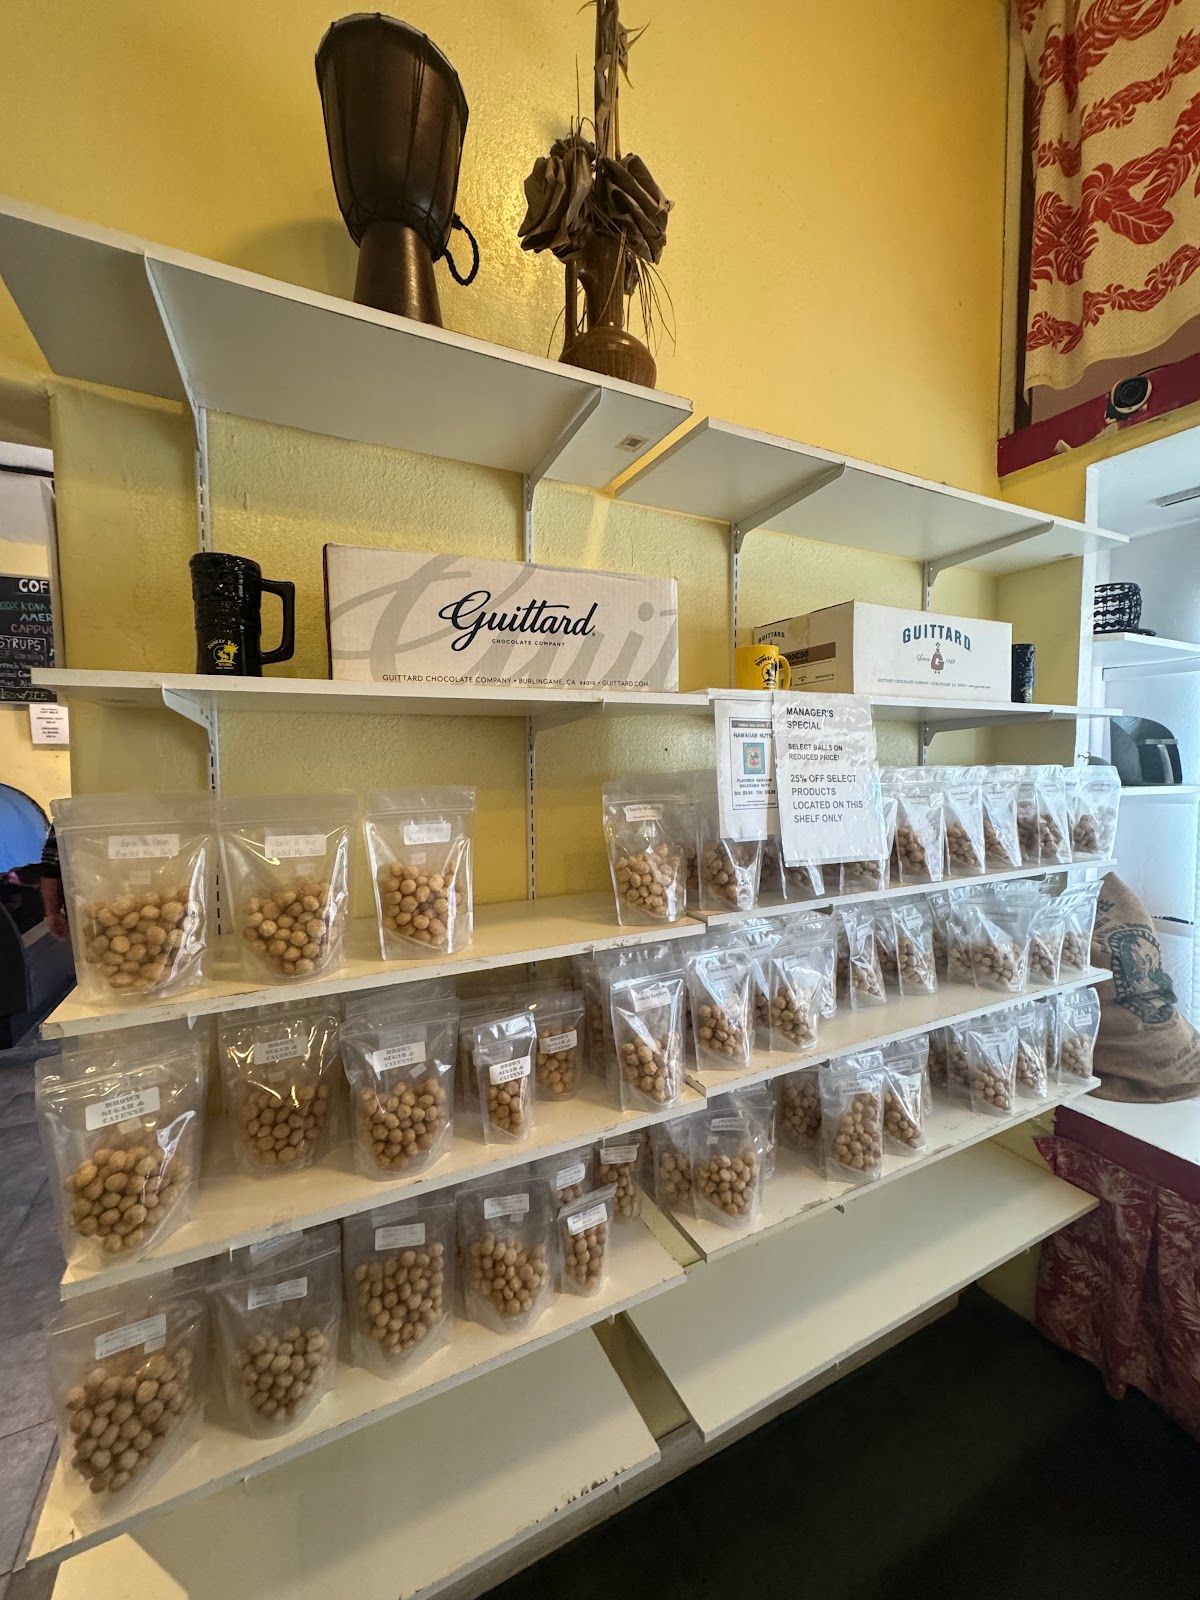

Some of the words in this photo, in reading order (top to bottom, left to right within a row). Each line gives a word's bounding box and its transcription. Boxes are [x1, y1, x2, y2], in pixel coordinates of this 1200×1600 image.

[438, 590, 598, 652] Guittard
[492, 638, 532, 646] CHOCOLATE
[902, 624, 971, 651] GUITTARD
[382, 674, 423, 682] GUITTARD
[426, 675, 473, 683] CHOCOLATE
[476, 676, 512, 684] COMPANY
[566, 678, 576, 686] CA
[786, 707, 834, 718] MANAGER'S
[786, 720, 822, 730] SPECIAL
[790, 774, 807, 782] 25%
[808, 774, 824, 782] OFF
[826, 774, 856, 782] SELECT
[792, 788, 836, 796] PRODUCTS
[792, 800, 830, 810] LOCATED
[832, 800, 844, 808] ON
[846, 800, 864, 808] THIS
[794, 814, 820, 823] SHELF
[822, 814, 842, 822] ONLY
